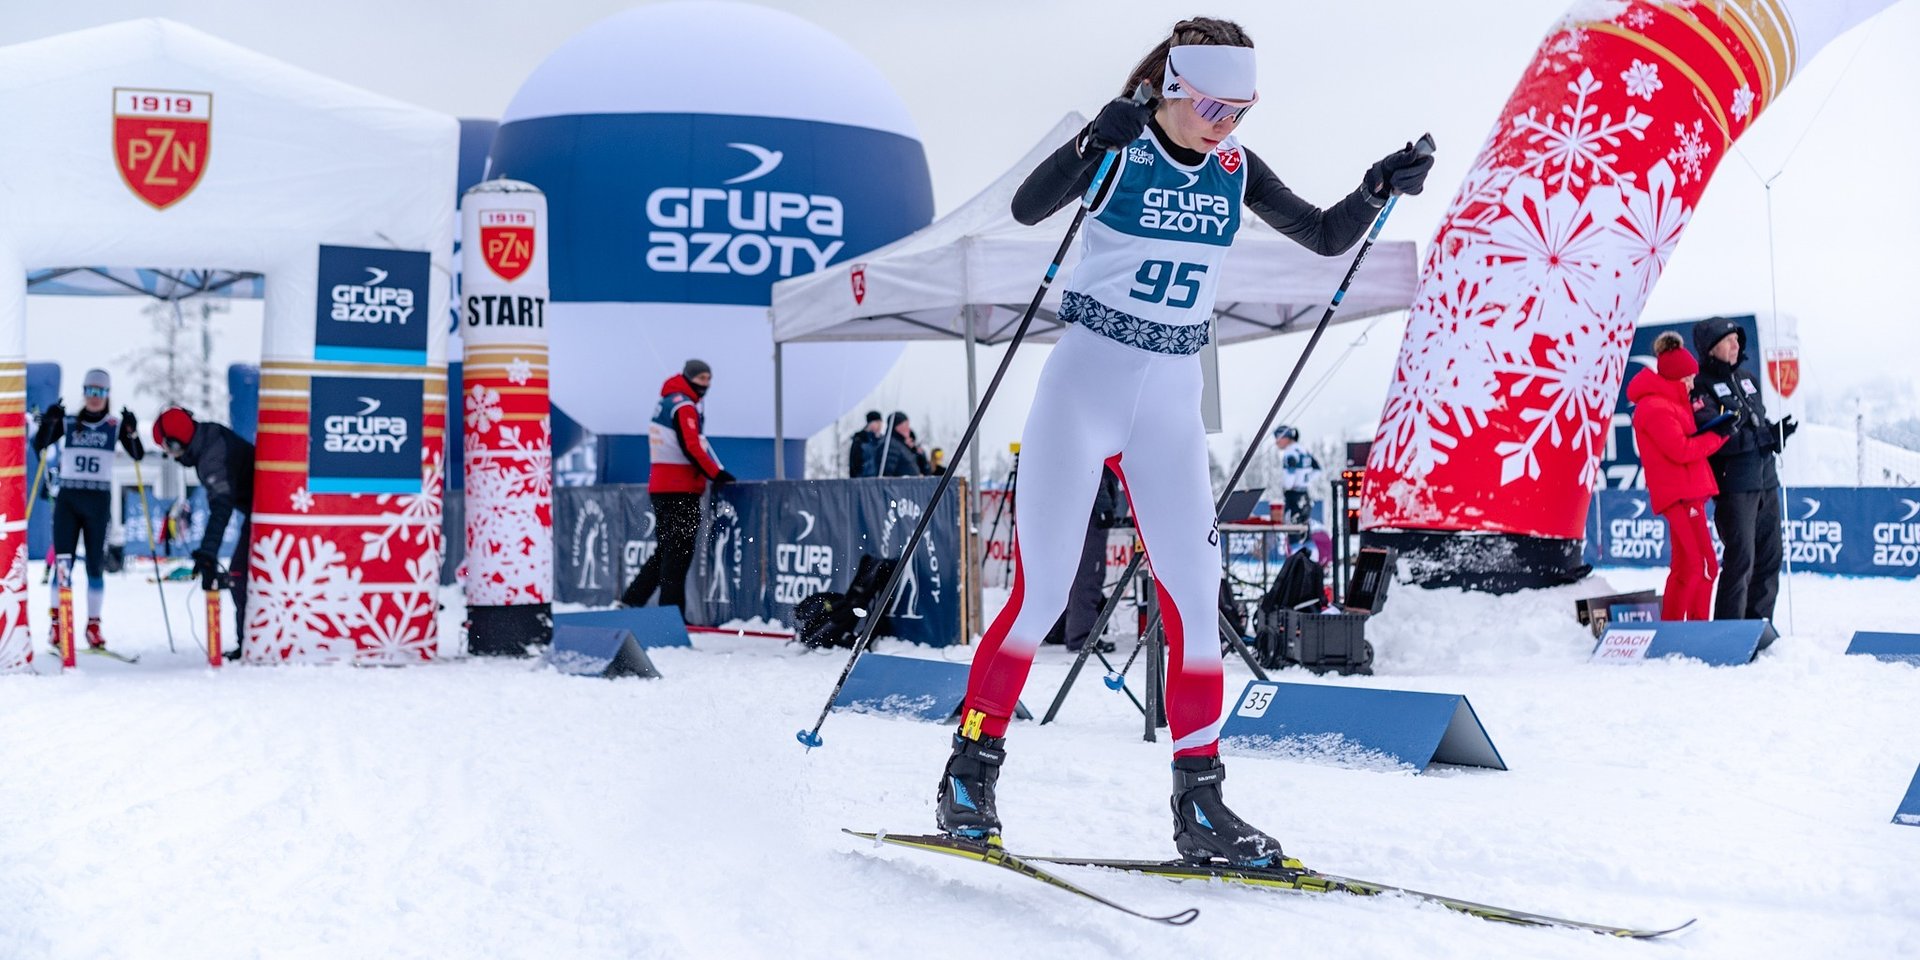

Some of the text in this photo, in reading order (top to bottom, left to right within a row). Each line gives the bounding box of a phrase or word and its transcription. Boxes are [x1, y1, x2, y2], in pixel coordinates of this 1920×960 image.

[1168, 83, 1181, 92] 4F
[131, 96, 192, 113] 1919
[127, 128, 196, 186] PZN
[488, 213, 526, 224] 1919
[488, 232, 530, 268] PZN
[1129, 259, 1209, 308] 95
[467, 295, 545, 328] START
[75, 456, 100, 473] 96
[1605, 635, 1651, 646] COACH
[1601, 649, 1637, 658] ZONE
[1244, 691, 1272, 711] 35
